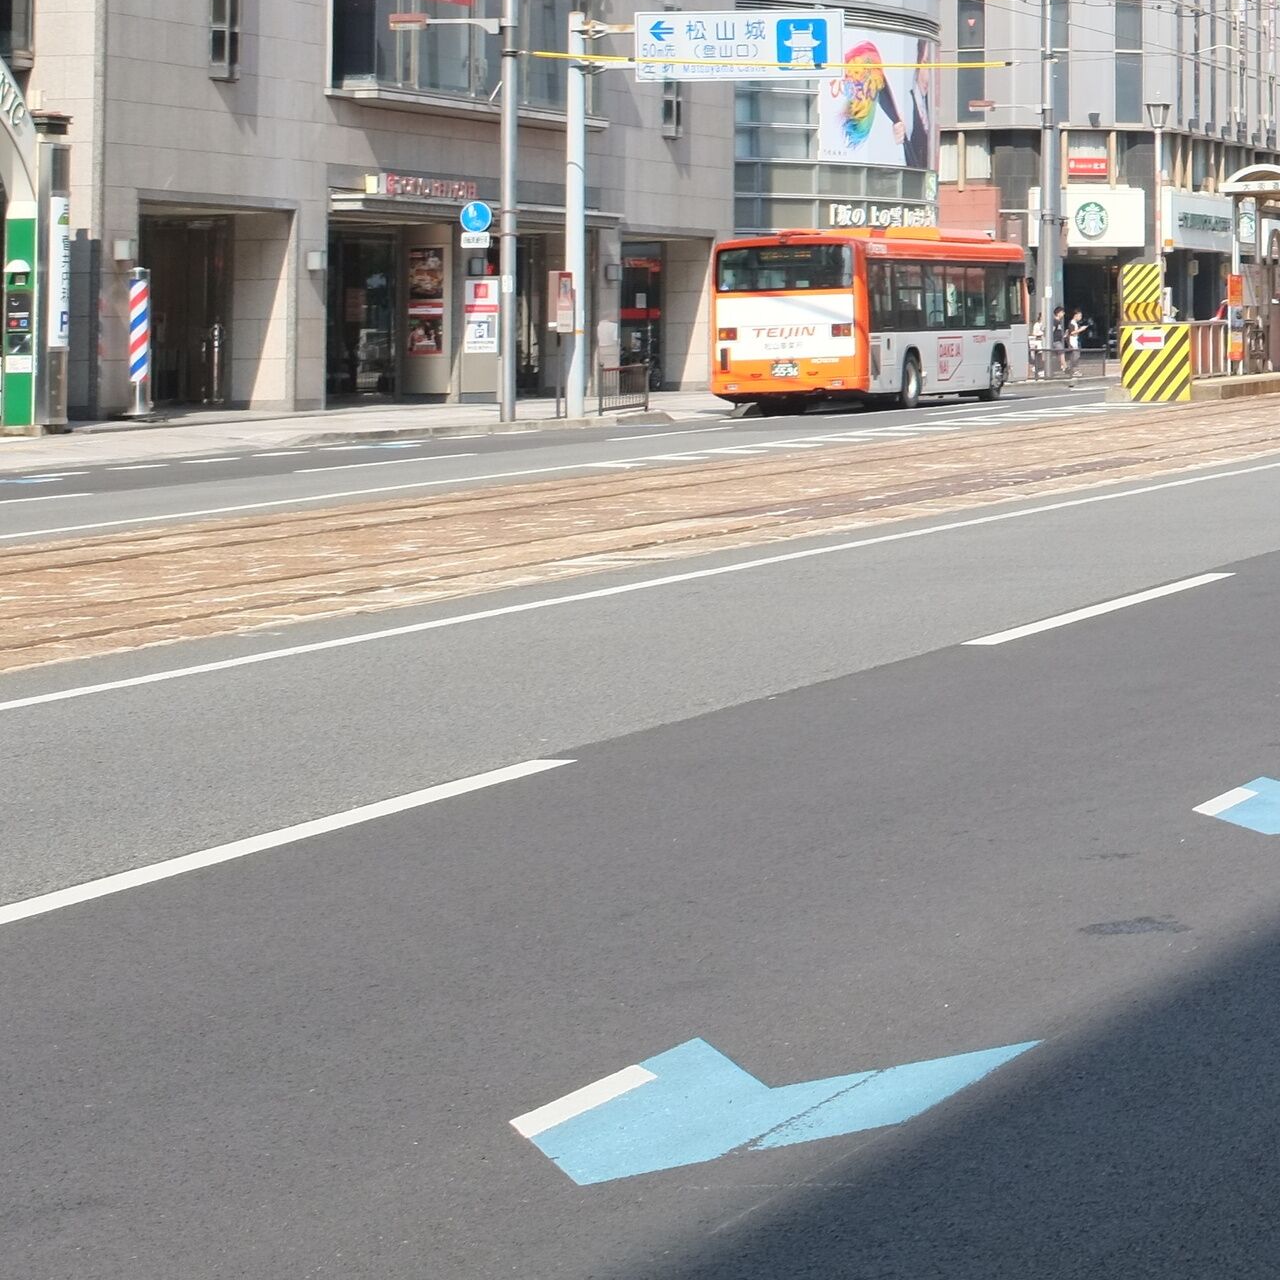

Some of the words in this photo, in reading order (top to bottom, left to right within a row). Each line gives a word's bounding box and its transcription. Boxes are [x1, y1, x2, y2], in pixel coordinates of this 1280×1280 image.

[686, 20, 766, 41] 松山城
[752, 326, 816, 339] TEIJIN
